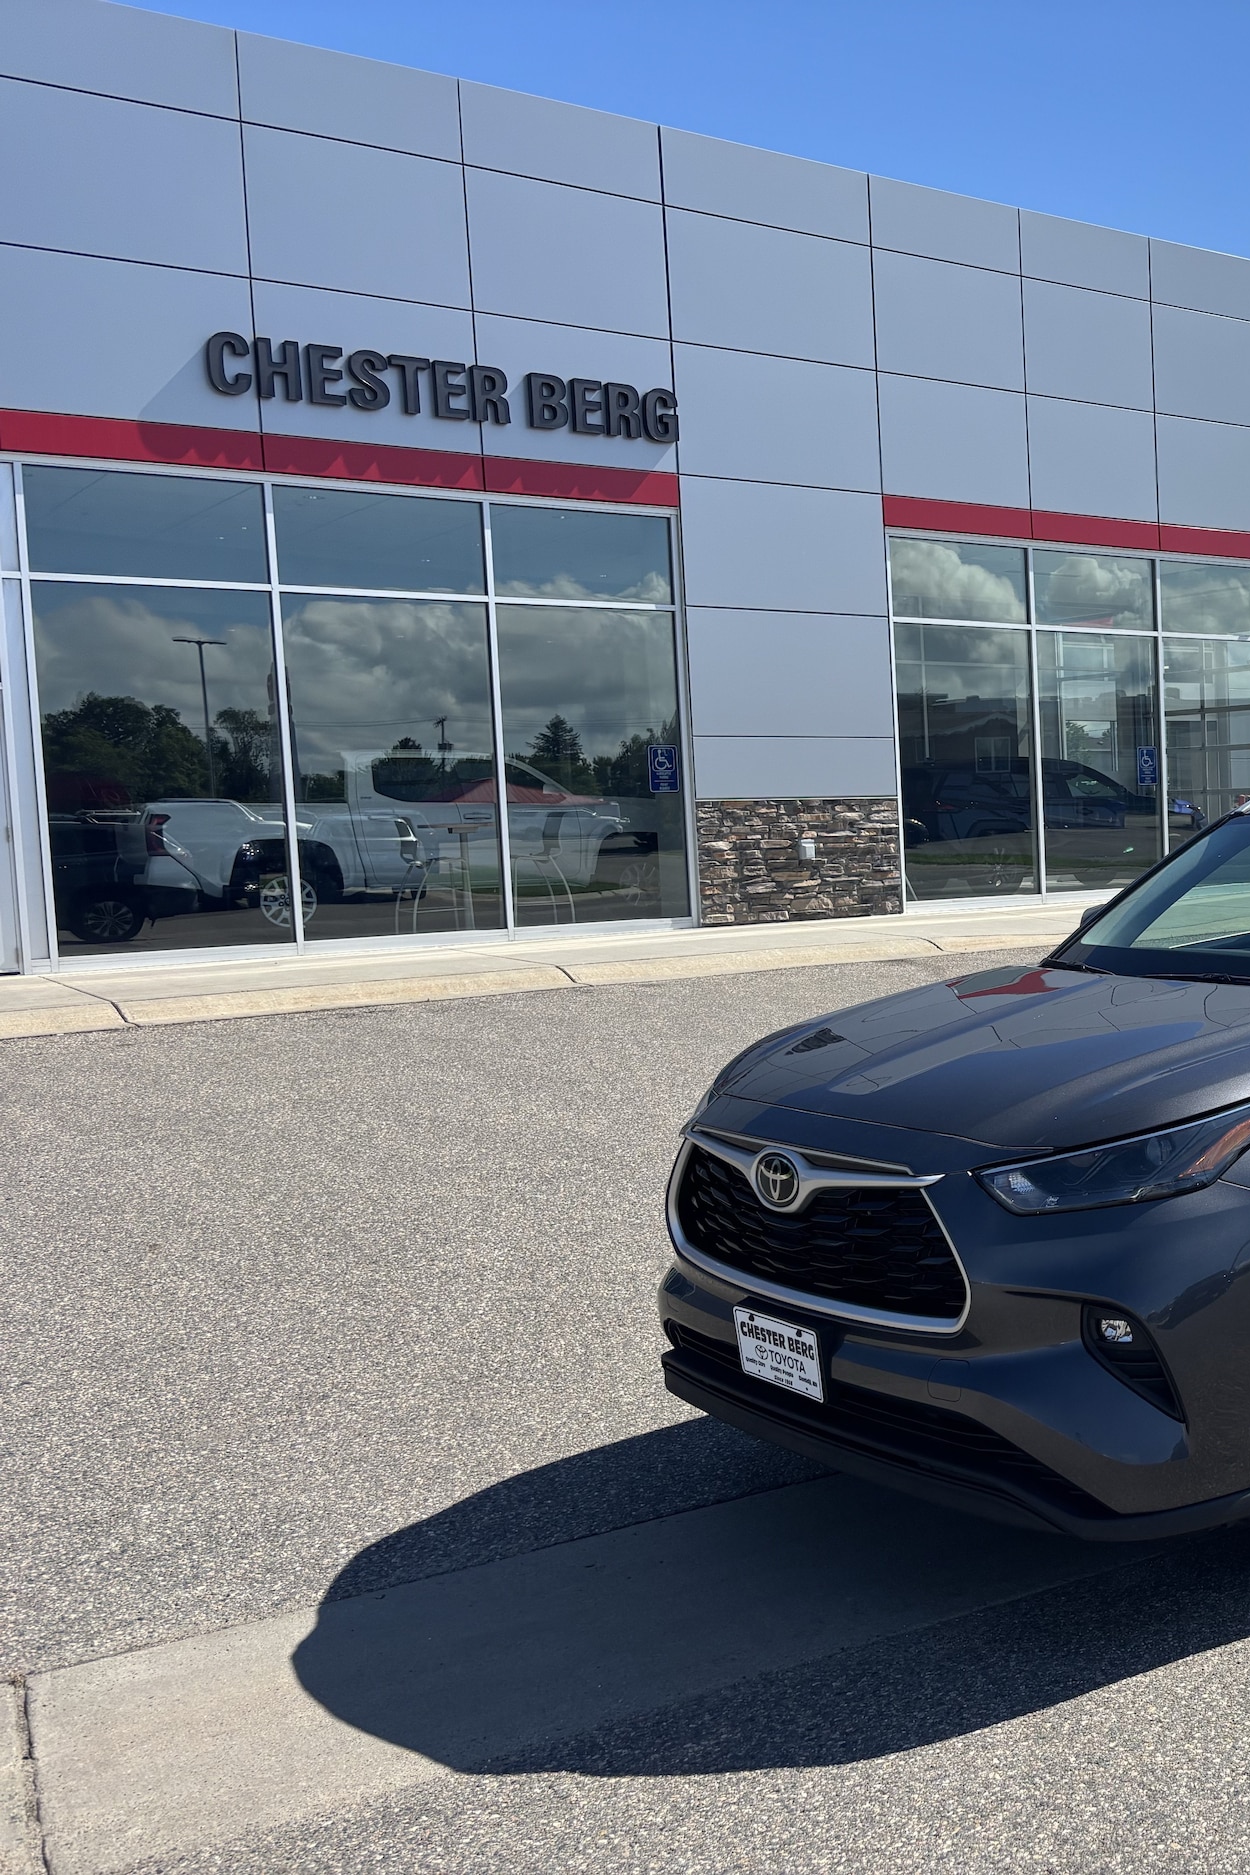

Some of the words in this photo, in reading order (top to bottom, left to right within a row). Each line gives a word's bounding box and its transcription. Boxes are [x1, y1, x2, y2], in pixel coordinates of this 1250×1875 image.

[206, 331, 511, 424] CHESTER
[526, 372, 680, 442] BERG
[741, 1321, 786, 1349] CHESTER
[787, 1336, 815, 1360] BERG
[769, 1349, 806, 1374] TOYOTA
